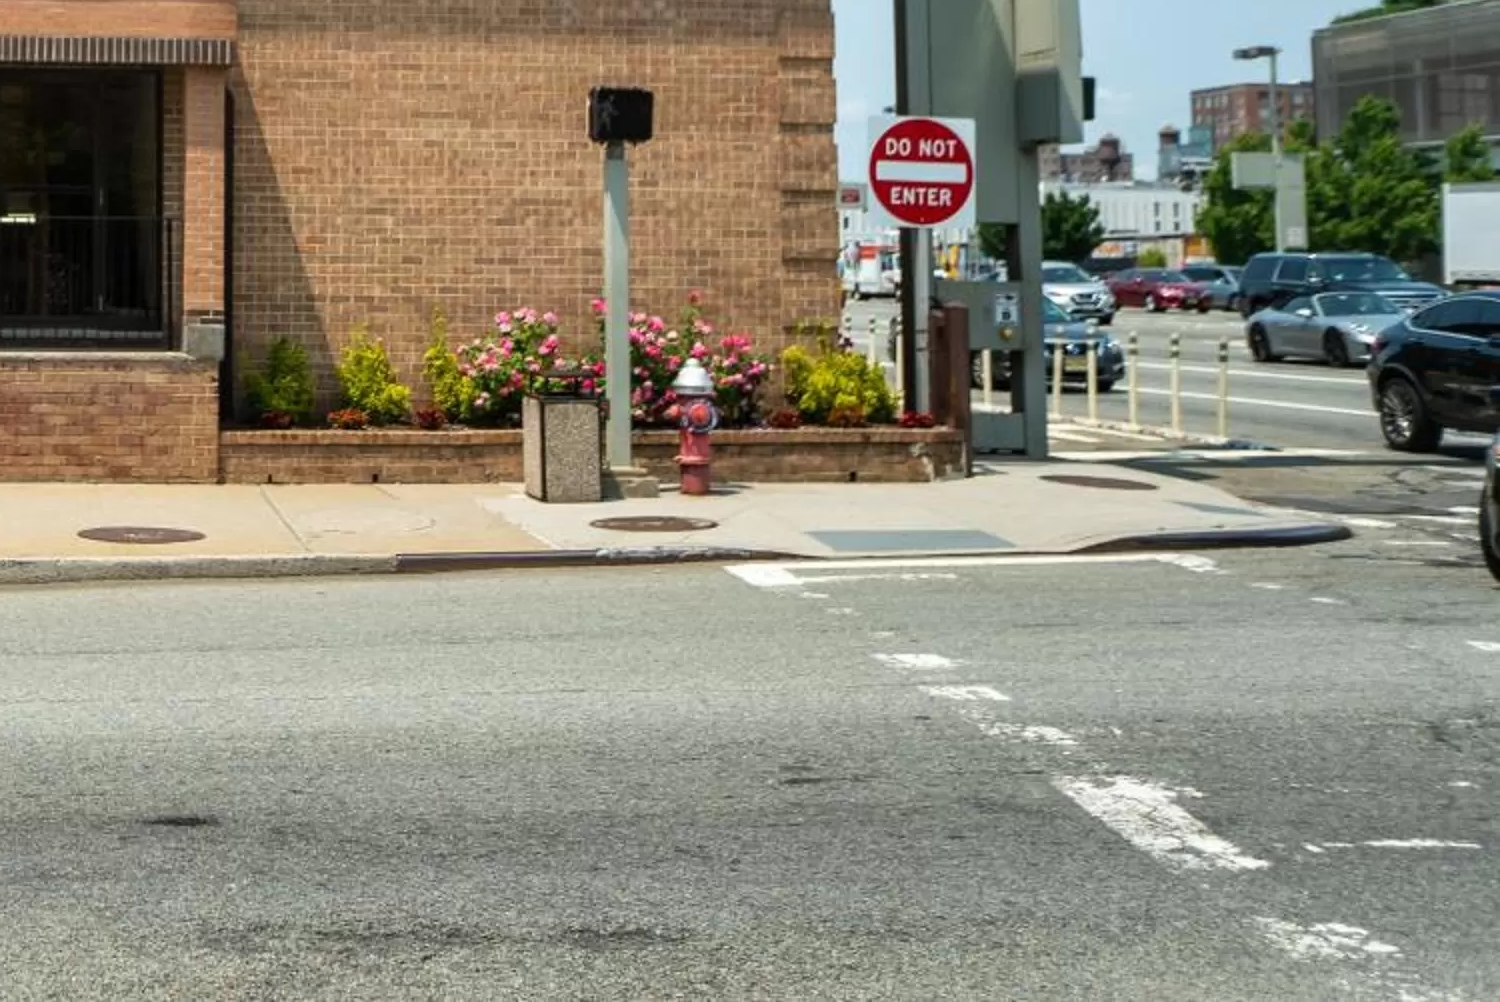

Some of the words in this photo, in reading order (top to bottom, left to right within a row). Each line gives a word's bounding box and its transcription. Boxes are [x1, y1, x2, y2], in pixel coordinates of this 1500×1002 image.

[885, 137, 911, 156] DO
[919, 139, 957, 158] NOT
[890, 187, 952, 206] ENTER
